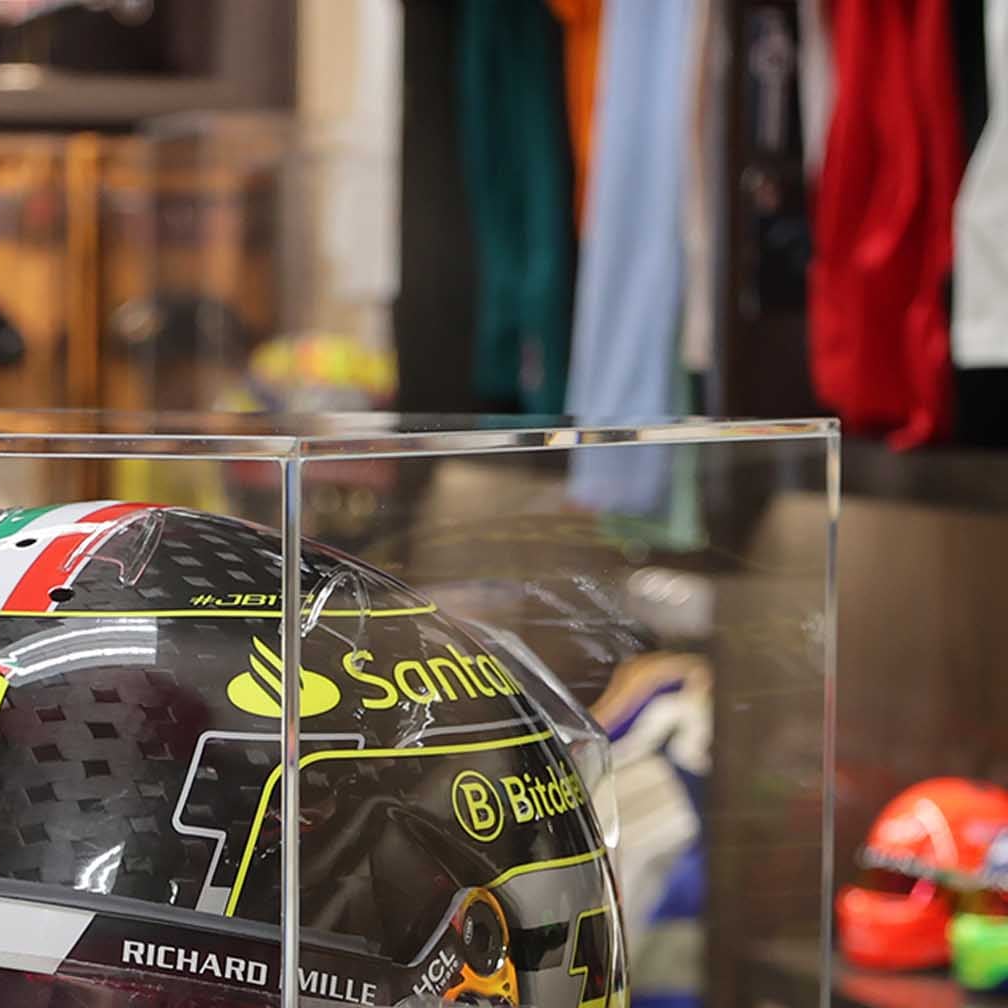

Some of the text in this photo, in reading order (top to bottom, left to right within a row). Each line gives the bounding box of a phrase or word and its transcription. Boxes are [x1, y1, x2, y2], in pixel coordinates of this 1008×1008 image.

[342, 643, 522, 709] Santa
[122, 939, 377, 1006] RICHARD MILLE
[413, 949, 456, 996] HCL
